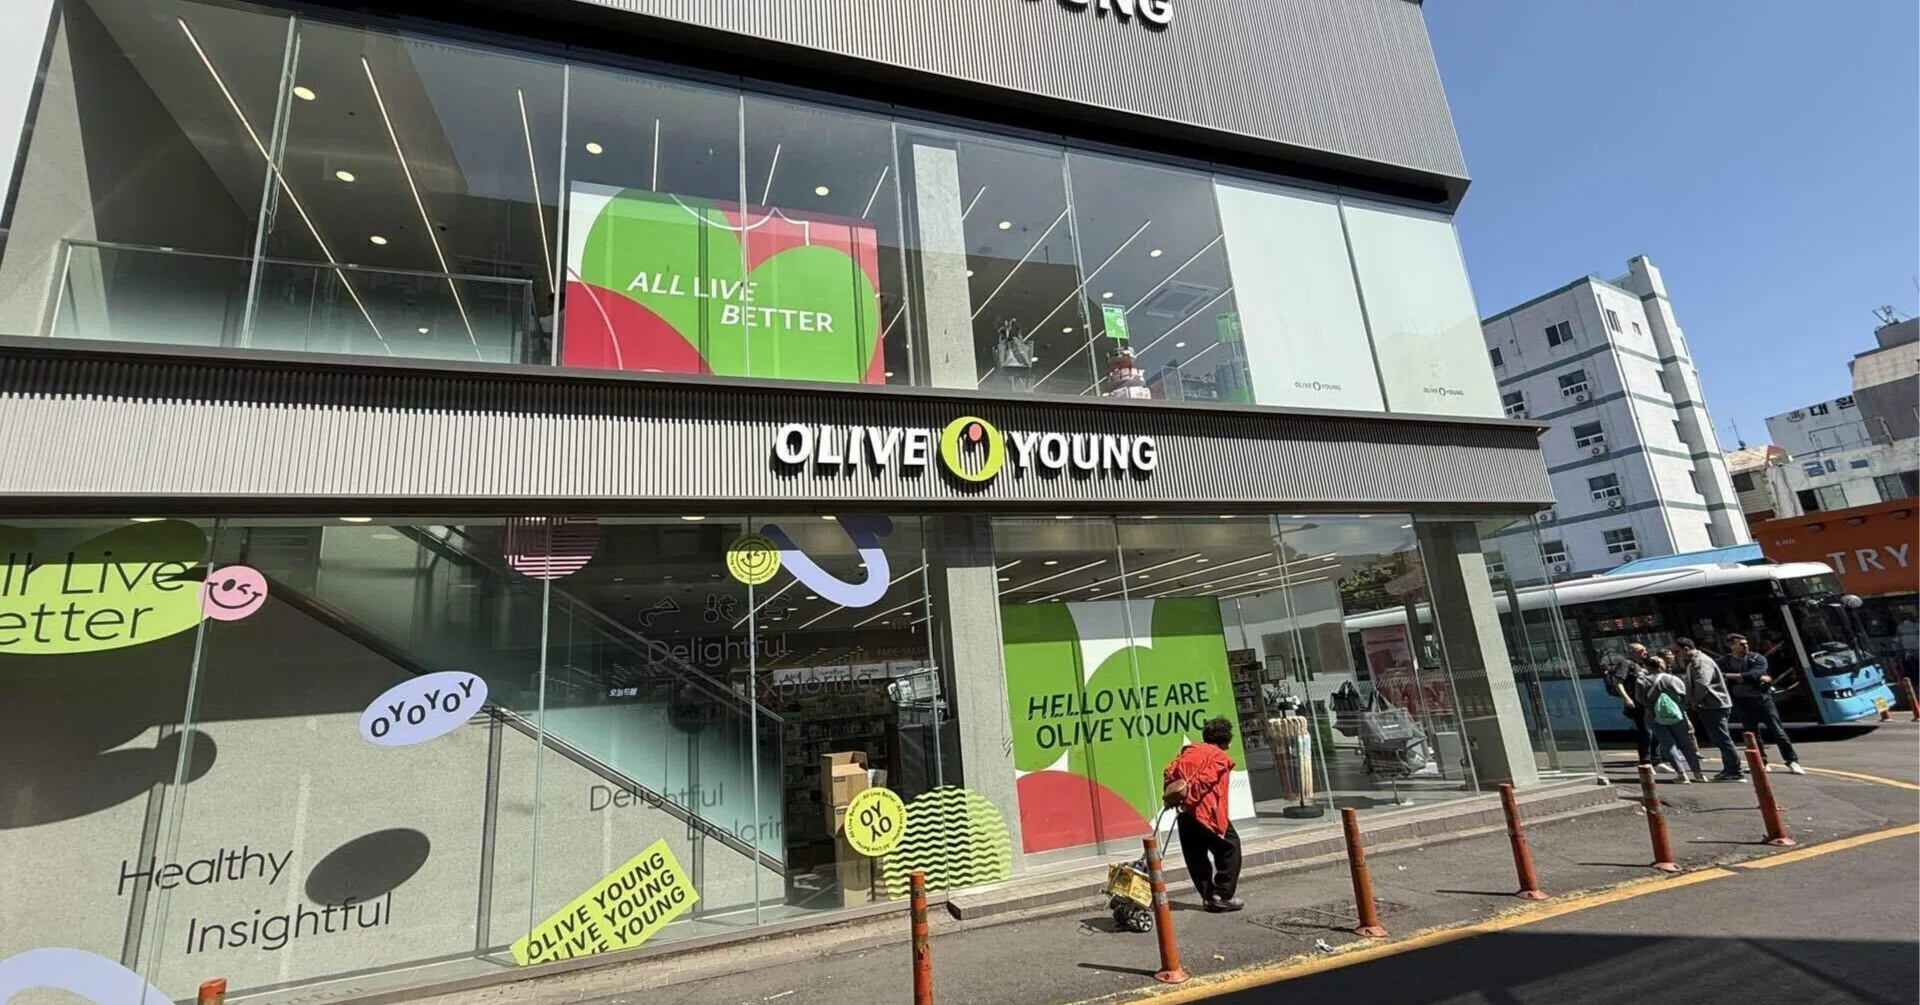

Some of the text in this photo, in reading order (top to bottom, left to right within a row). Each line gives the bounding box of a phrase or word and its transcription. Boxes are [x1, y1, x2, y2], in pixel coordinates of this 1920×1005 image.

[627, 271, 758, 302] ALL LIVE
[720, 304, 834, 333] BETTER
[775, 423, 1158, 471] OLIVE YOUNG
[61, 551, 188, 595] Live
[1826, 543, 1909, 575] TRY
[648, 632, 787, 668] Delightful
[370, 678, 475, 737] OYOYOY
[1028, 681, 1209, 720] HELLO WE ARE
[1036, 718, 1113, 749] OLIVE
[590, 782, 723, 811] Delightful
[117, 845, 294, 896] Healthy
[526, 852, 665, 960] OLIVE YOUNG
[603, 869, 675, 927] YOUNG
[614, 886, 686, 945] YOUNG
[186, 892, 392, 954] Insightful
